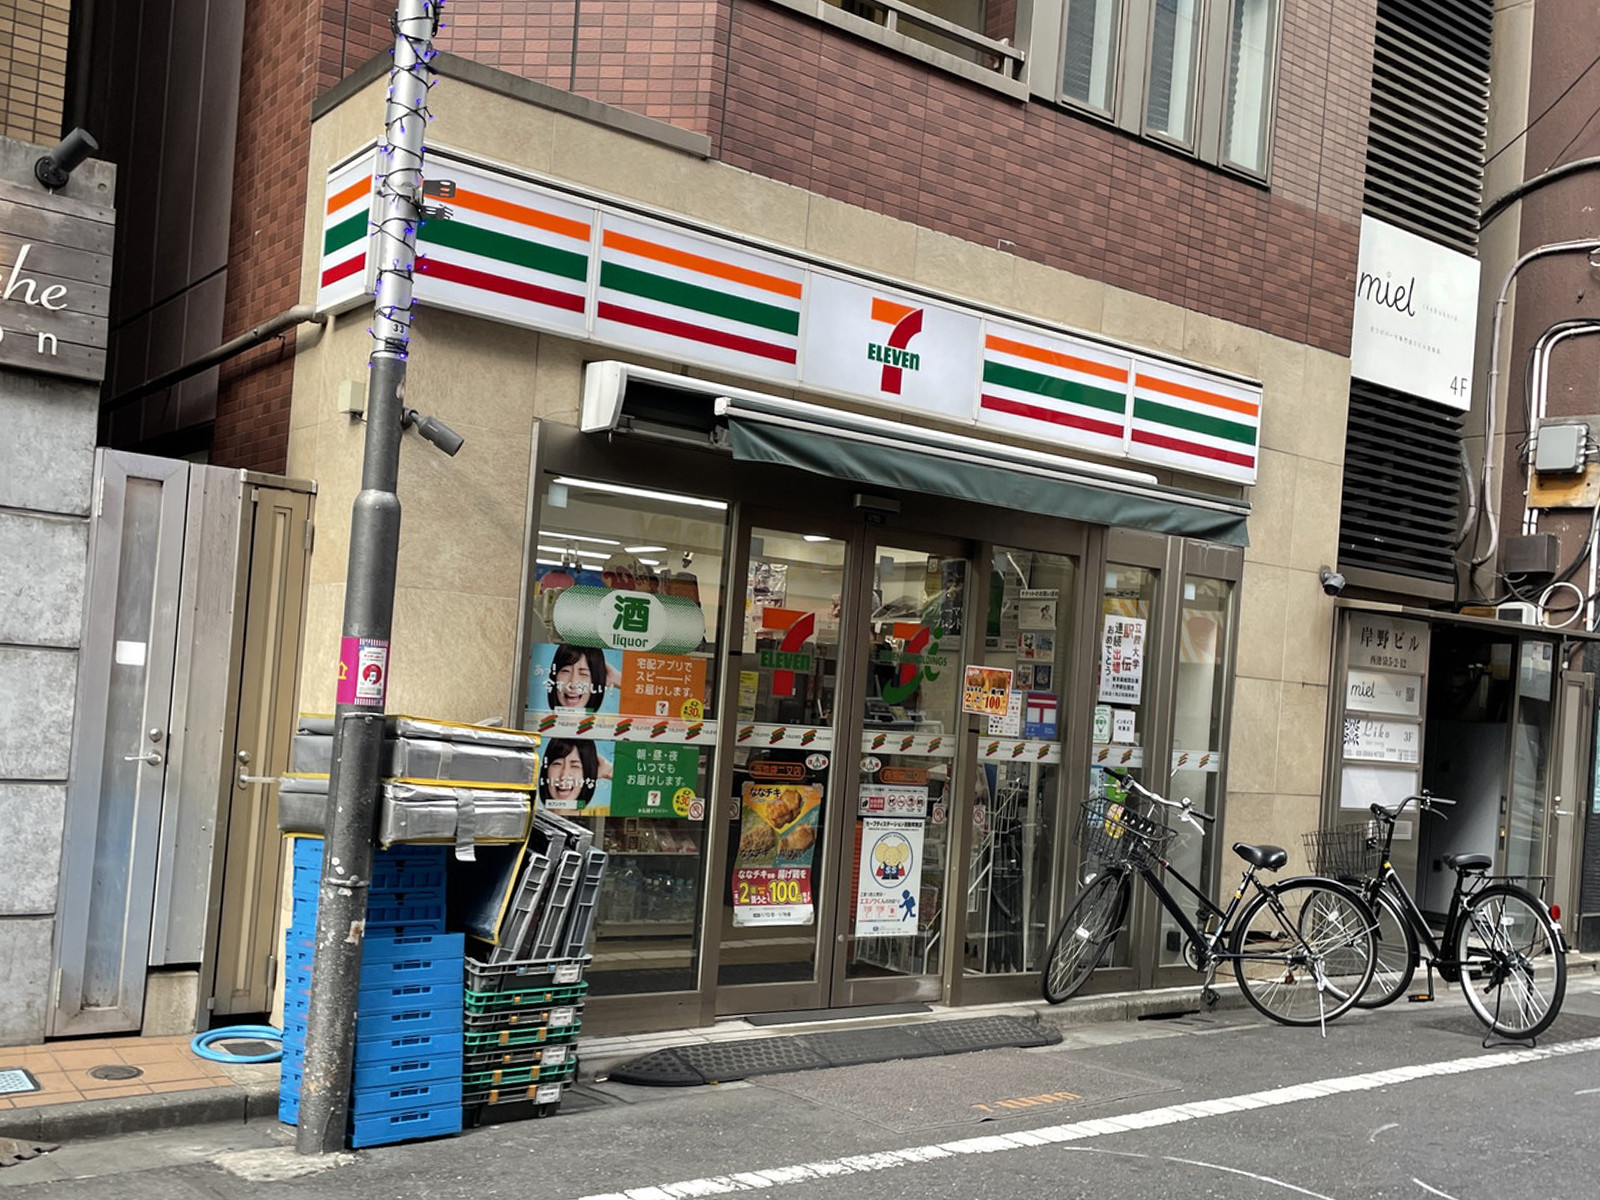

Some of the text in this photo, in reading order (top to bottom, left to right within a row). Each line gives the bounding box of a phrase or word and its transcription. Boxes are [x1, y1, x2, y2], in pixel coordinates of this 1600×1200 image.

[0, 244, 68, 310] he
[1358, 271, 1415, 316] miel
[393, 324, 405, 333] 33
[1450, 376, 1468, 397] 4F
[612, 595, 651, 633] 酒
[612, 633, 649, 648] liquor
[1361, 626, 1420, 651] 岸野ビル
[637, 657, 693, 673] 宅配アプリで
[1350, 682, 1375, 698] miel
[1403, 731, 1414, 742] 3F
[636, 762, 675, 774] いつでも
[626, 774, 686, 787] お届けします。
[750, 787, 780, 797] ななチキ
[740, 882, 750, 903] 2
[769, 880, 799, 903] 100
